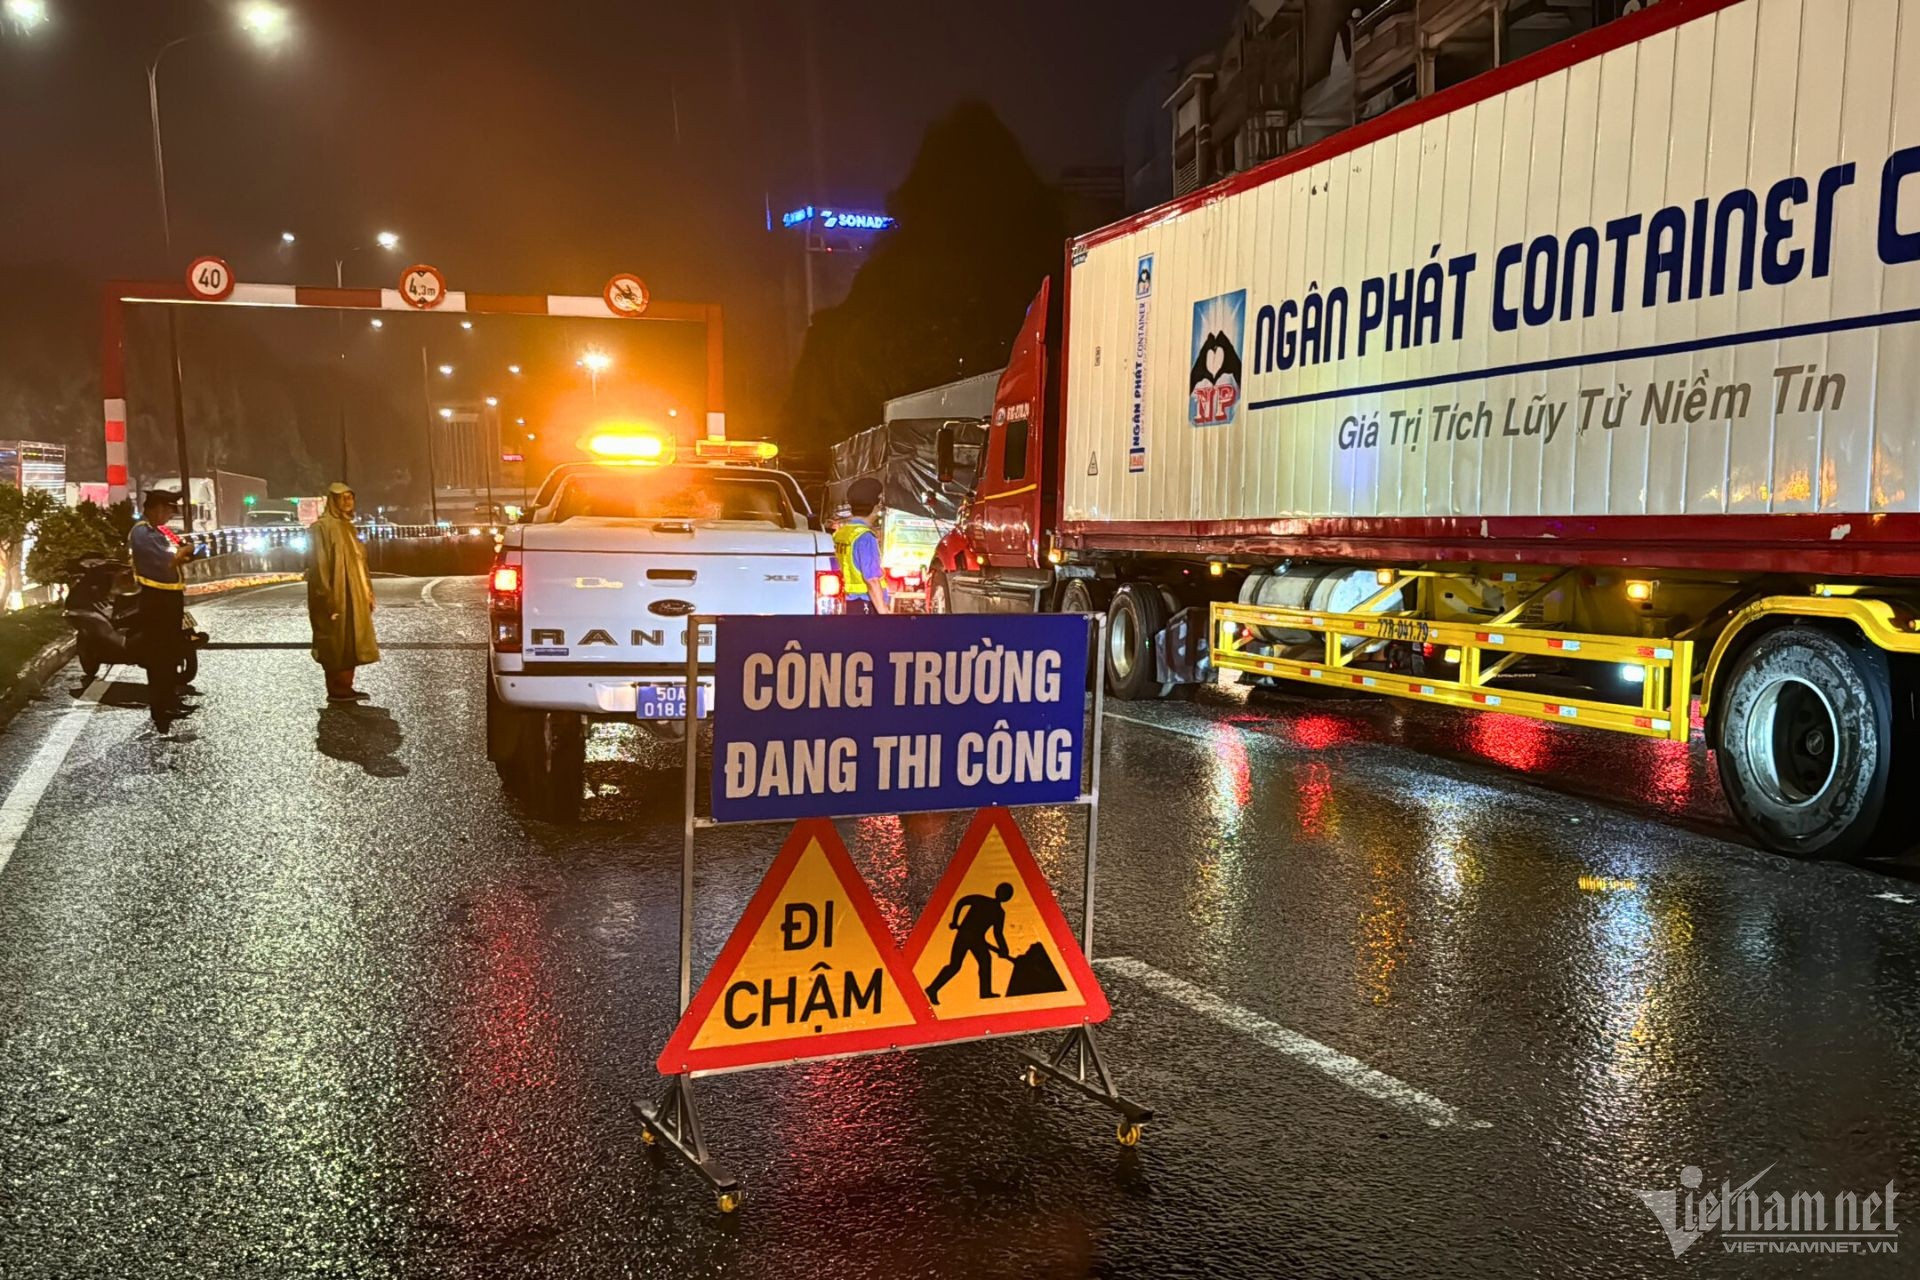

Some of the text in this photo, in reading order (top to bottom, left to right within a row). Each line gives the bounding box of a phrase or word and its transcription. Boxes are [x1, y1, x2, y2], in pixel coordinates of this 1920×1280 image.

[198, 268, 221, 289] 40
[408, 277, 436, 296] 4.3m
[1254, 281, 1348, 375] NGÂN
[1357, 244, 1476, 357] PHÁT
[1492, 162, 1856, 332] CONTAINER
[1194, 384, 1236, 424] NP
[1338, 363, 1846, 452] Giá Trị Tích Lũy Từ Niềm Tin
[656, 687, 687, 701] 50A
[743, 637, 1061, 711] CÔNG TRƯỜNG
[724, 720, 1072, 799] ĐANG THI CÔNG
[780, 900, 834, 951] ĐI
[724, 961, 883, 1033] CHẬM
